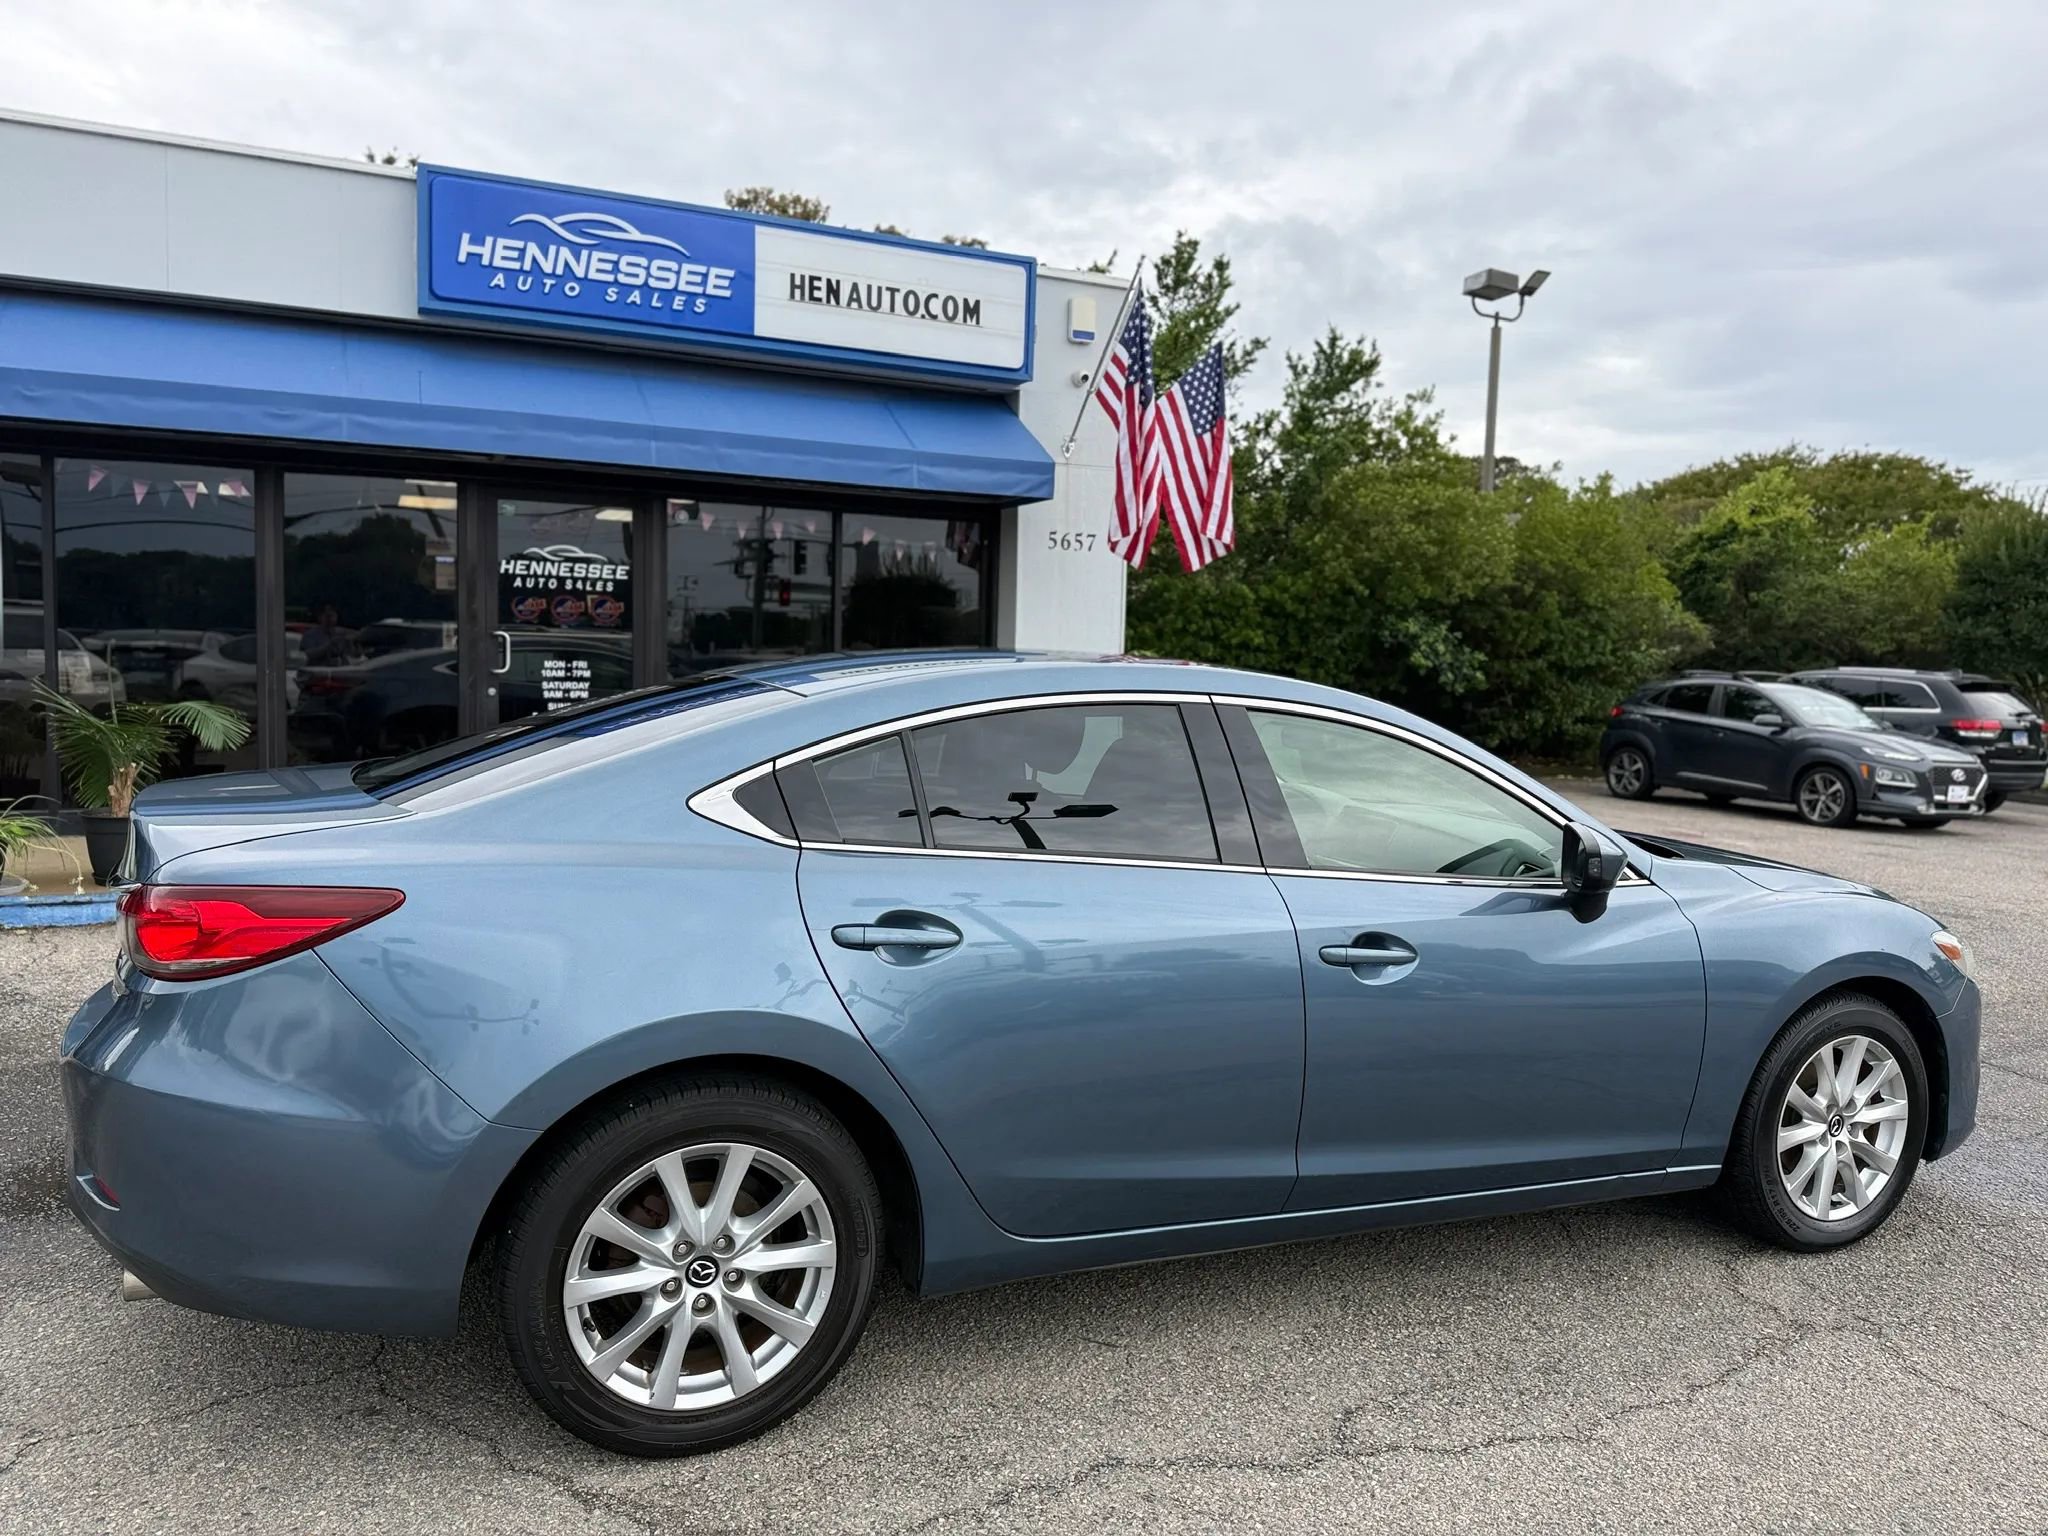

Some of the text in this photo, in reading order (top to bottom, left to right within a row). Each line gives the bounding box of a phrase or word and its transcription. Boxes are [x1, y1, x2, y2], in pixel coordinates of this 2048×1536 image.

[456, 232, 736, 298] HENNESSEE
[489, 272, 708, 314] AUTO SALES
[788, 272, 982, 326] HENAUTO.COM
[1047, 530, 1097, 552] 5657
[499, 559, 630, 580] HENNESSEE
[513, 578, 614, 592] AUTO SALES
[541, 669, 566, 678] 10AM
[571, 669, 591, 678] 7PM
[543, 660, 566, 669] MON
[572, 660, 588, 669] FRI
[541, 681, 590, 690] SATURDAY
